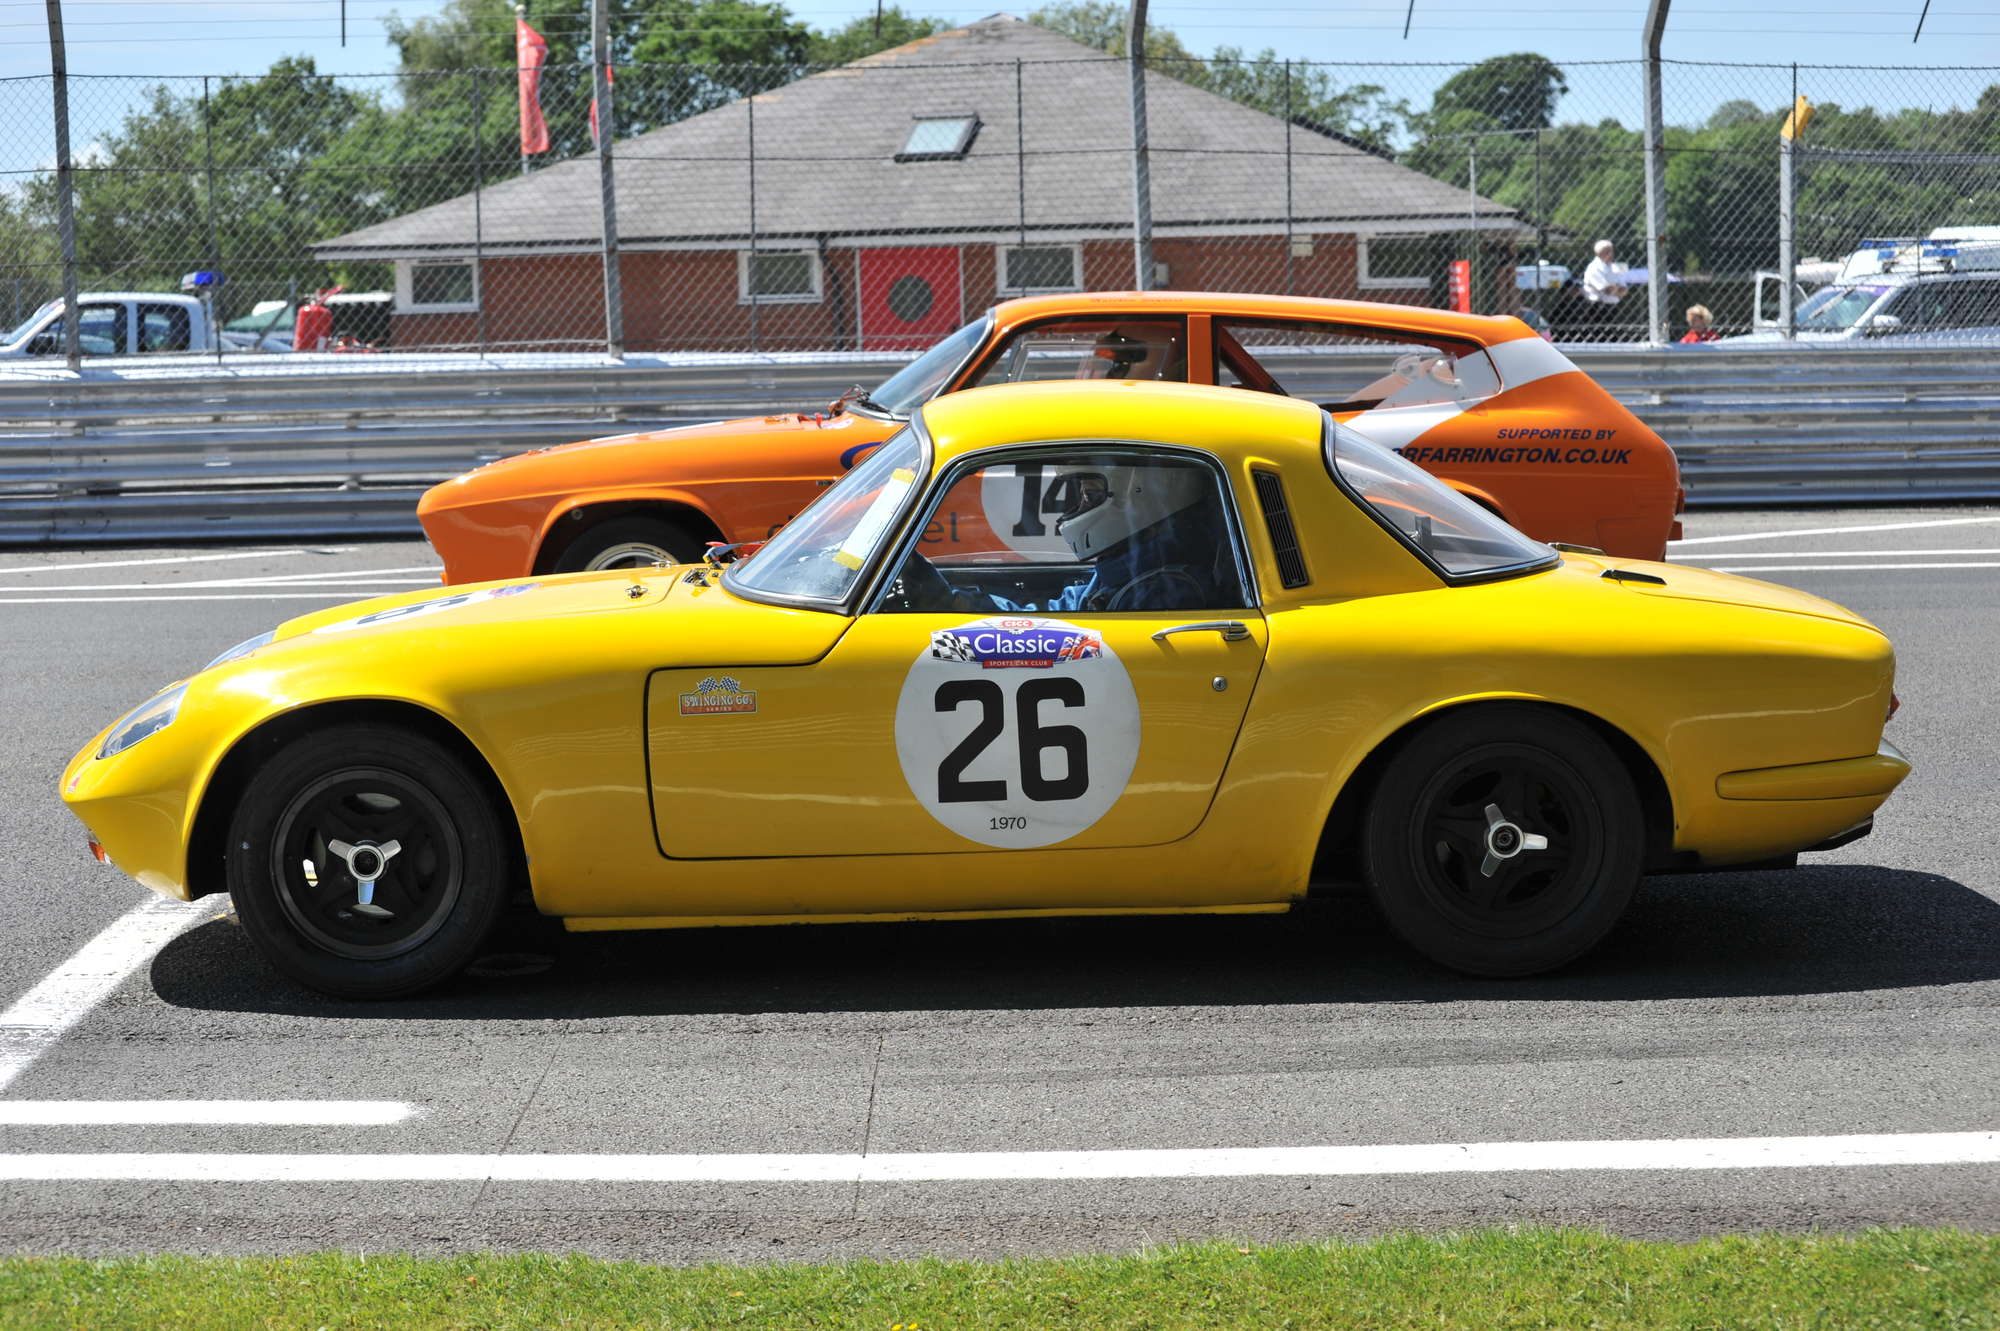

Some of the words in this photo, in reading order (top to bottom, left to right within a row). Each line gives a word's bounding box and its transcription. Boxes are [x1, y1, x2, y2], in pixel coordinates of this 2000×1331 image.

[1497, 428, 1591, 440] SUPPORTED
[1595, 429, 1616, 440] BY
[974, 633, 1056, 654] Classic
[934, 676, 1089, 803] 26
[990, 816, 1027, 830] 1970
